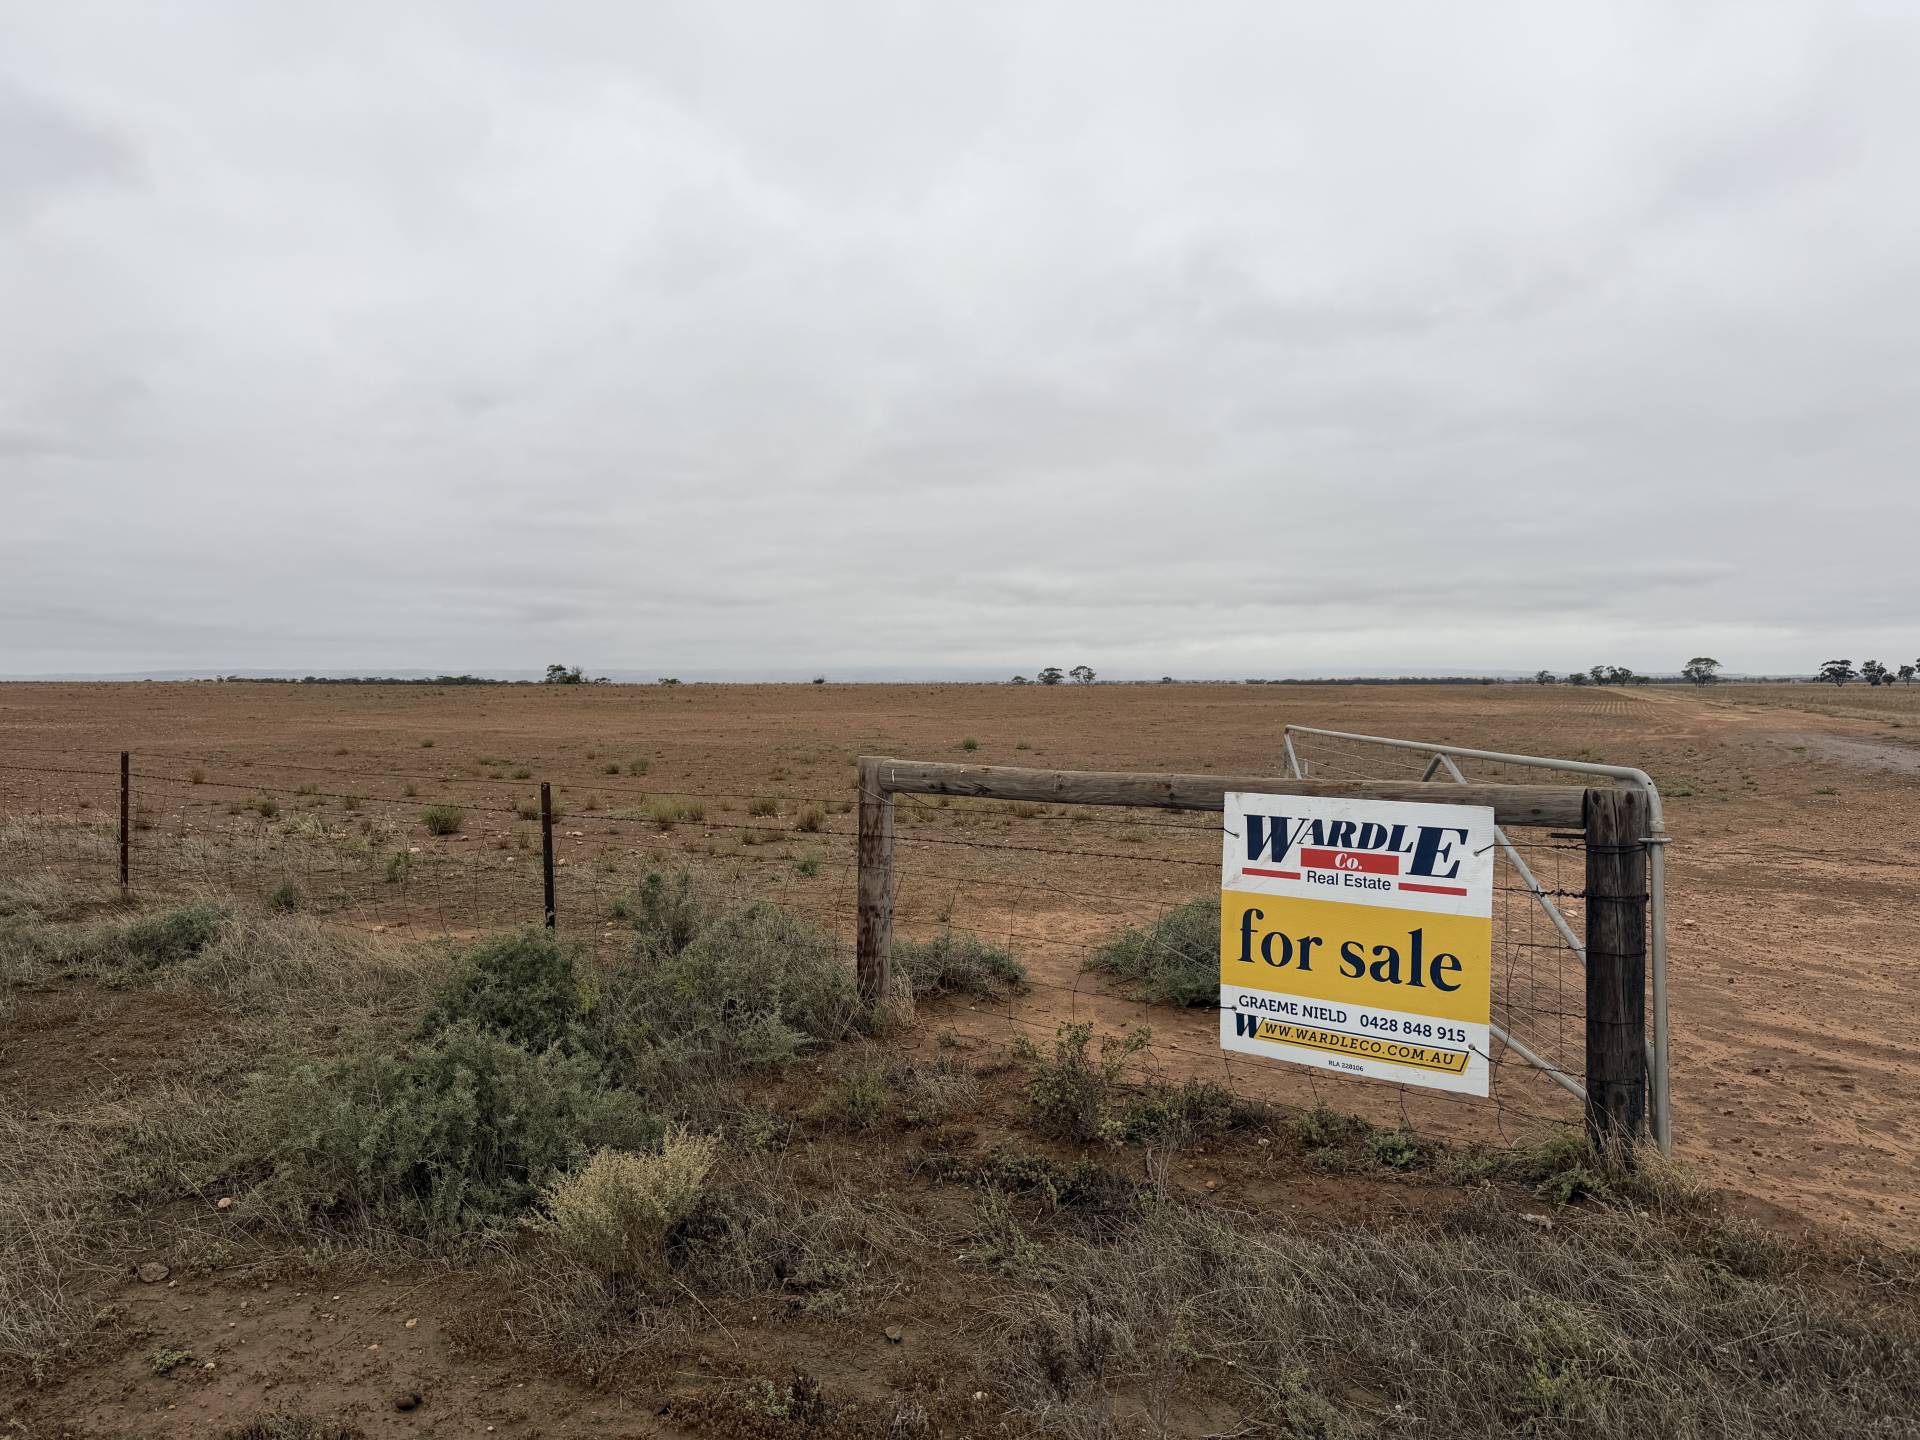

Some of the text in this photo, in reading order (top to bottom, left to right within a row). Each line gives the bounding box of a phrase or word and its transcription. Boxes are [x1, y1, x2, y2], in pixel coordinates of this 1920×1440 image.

[1242, 813, 1469, 879] WARDLE
[1306, 870, 1392, 891] Real Estate
[1237, 908, 1463, 992] for sale
[1238, 994, 1467, 1043] GRAEME NIELD 0428 848 915
[1328, 1059, 1340, 1067] RLA
